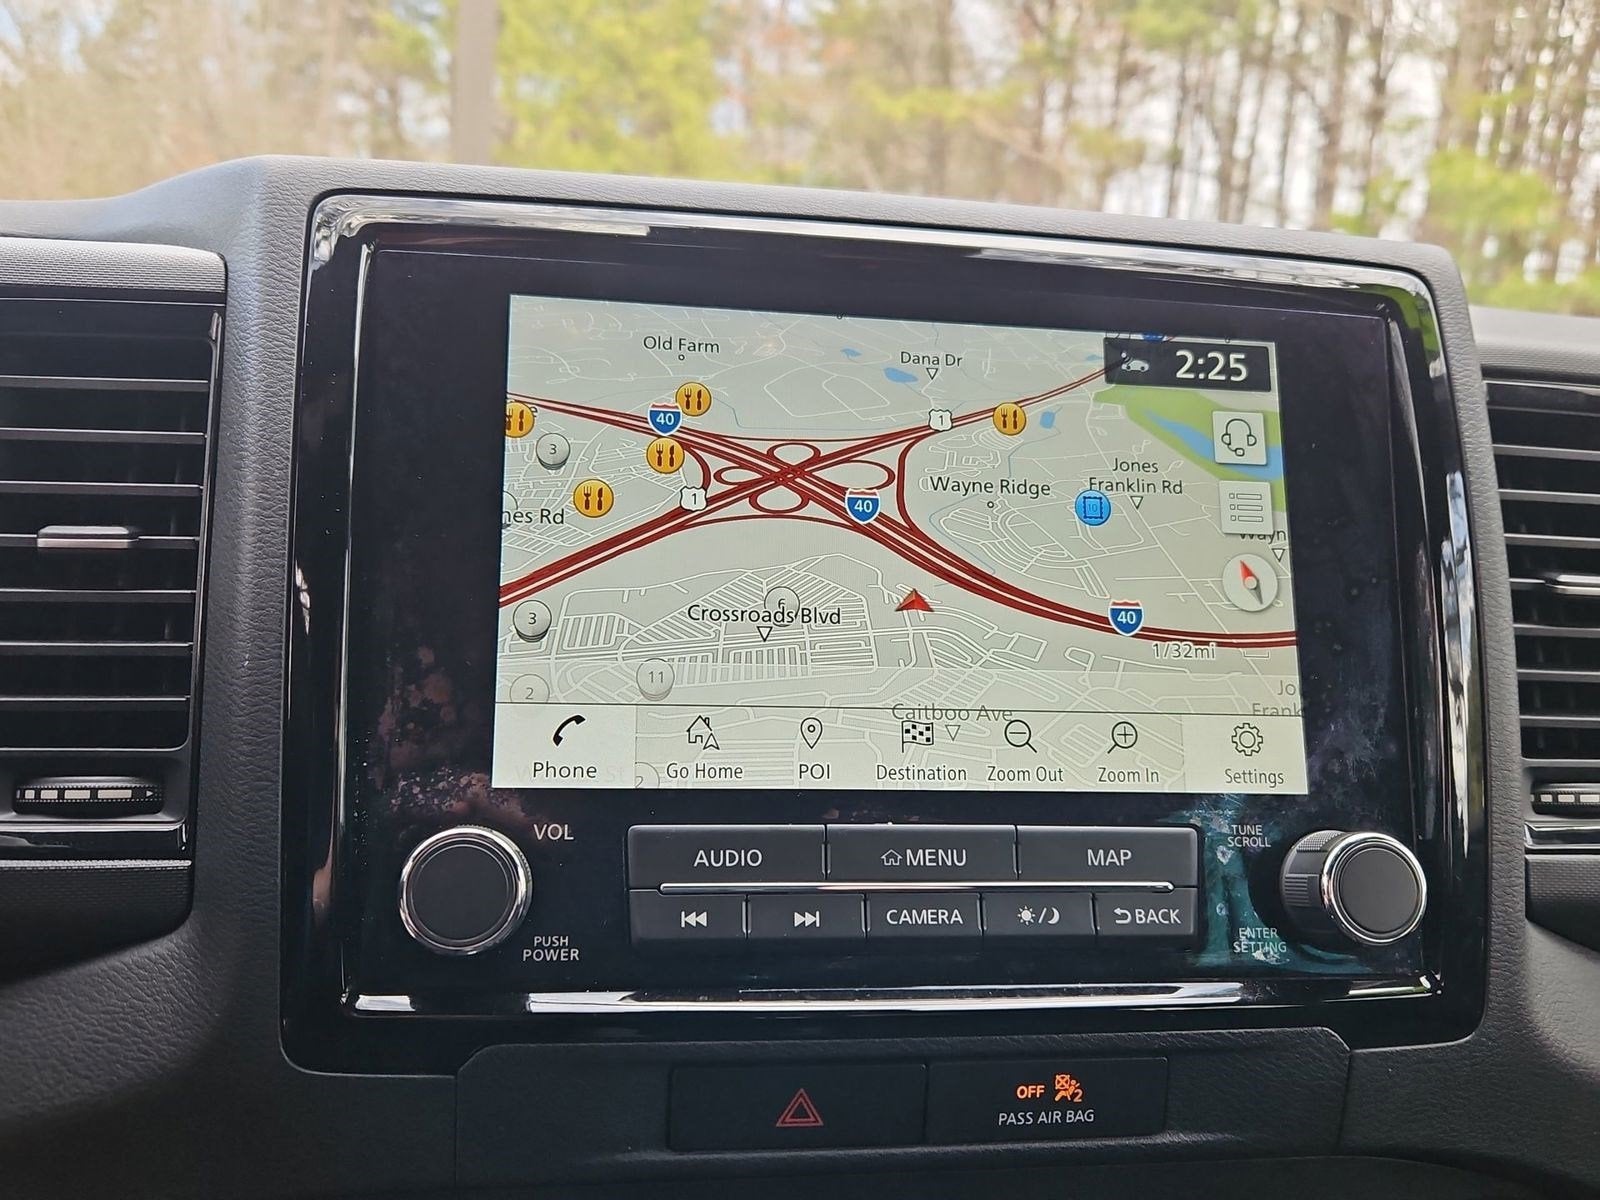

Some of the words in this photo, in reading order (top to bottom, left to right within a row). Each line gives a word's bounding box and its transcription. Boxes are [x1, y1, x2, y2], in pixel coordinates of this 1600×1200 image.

[643, 336, 672, 350] Old
[679, 338, 720, 353] Farm
[900, 351, 941, 366] Dana
[945, 353, 963, 367] Dr
[1175, 350, 1248, 382] 2:25
[656, 412, 675, 426] 40
[549, 443, 557, 455] 3
[1112, 457, 1159, 473] Jones
[929, 476, 994, 497] Wayne
[1000, 479, 1051, 499] Ridge
[1089, 477, 1156, 494] Franklin
[1162, 480, 1183, 495] Rd
[854, 499, 873, 513] 40
[540, 508, 565, 525] Rd
[528, 612, 537, 625] 3
[687, 604, 795, 624] Crossroads
[801, 607, 841, 624] Blvd
[1117, 610, 1136, 624] 40
[1153, 642, 1216, 659] 1/32mi
[648, 671, 664, 684] 11
[525, 687, 534, 700] 2
[1277, 680, 1296, 696] Jo
[976, 704, 1013, 722] Ave
[533, 761, 597, 778] Phone
[666, 762, 689, 778] Go
[695, 762, 743, 779] Home
[799, 763, 831, 780] POI
[876, 764, 967, 781] Destination
[987, 765, 1030, 782] Zoom
[1036, 766, 1064, 782] Out
[1098, 767, 1141, 783] Zoom
[1146, 768, 1160, 783] In
[1224, 768, 1285, 788] Settings
[533, 824, 574, 841] VOL
[1232, 824, 1263, 836] TUNE
[1228, 836, 1271, 848] SCROLL
[693, 849, 763, 867] AUDIO
[906, 849, 967, 867] MENU
[1087, 849, 1132, 866] MAP
[886, 908, 964, 925] CAMERA
[1135, 908, 1182, 925] BACK
[534, 935, 569, 947] PUSH
[1238, 927, 1278, 939] ENTER
[522, 948, 580, 962] POWER
[1233, 941, 1287, 953] SETTING
[1016, 1084, 1046, 1099] OFF
[998, 1111, 1034, 1126] PASS
[1037, 1110, 1062, 1125] AIR
[1066, 1109, 1095, 1123] BAG
